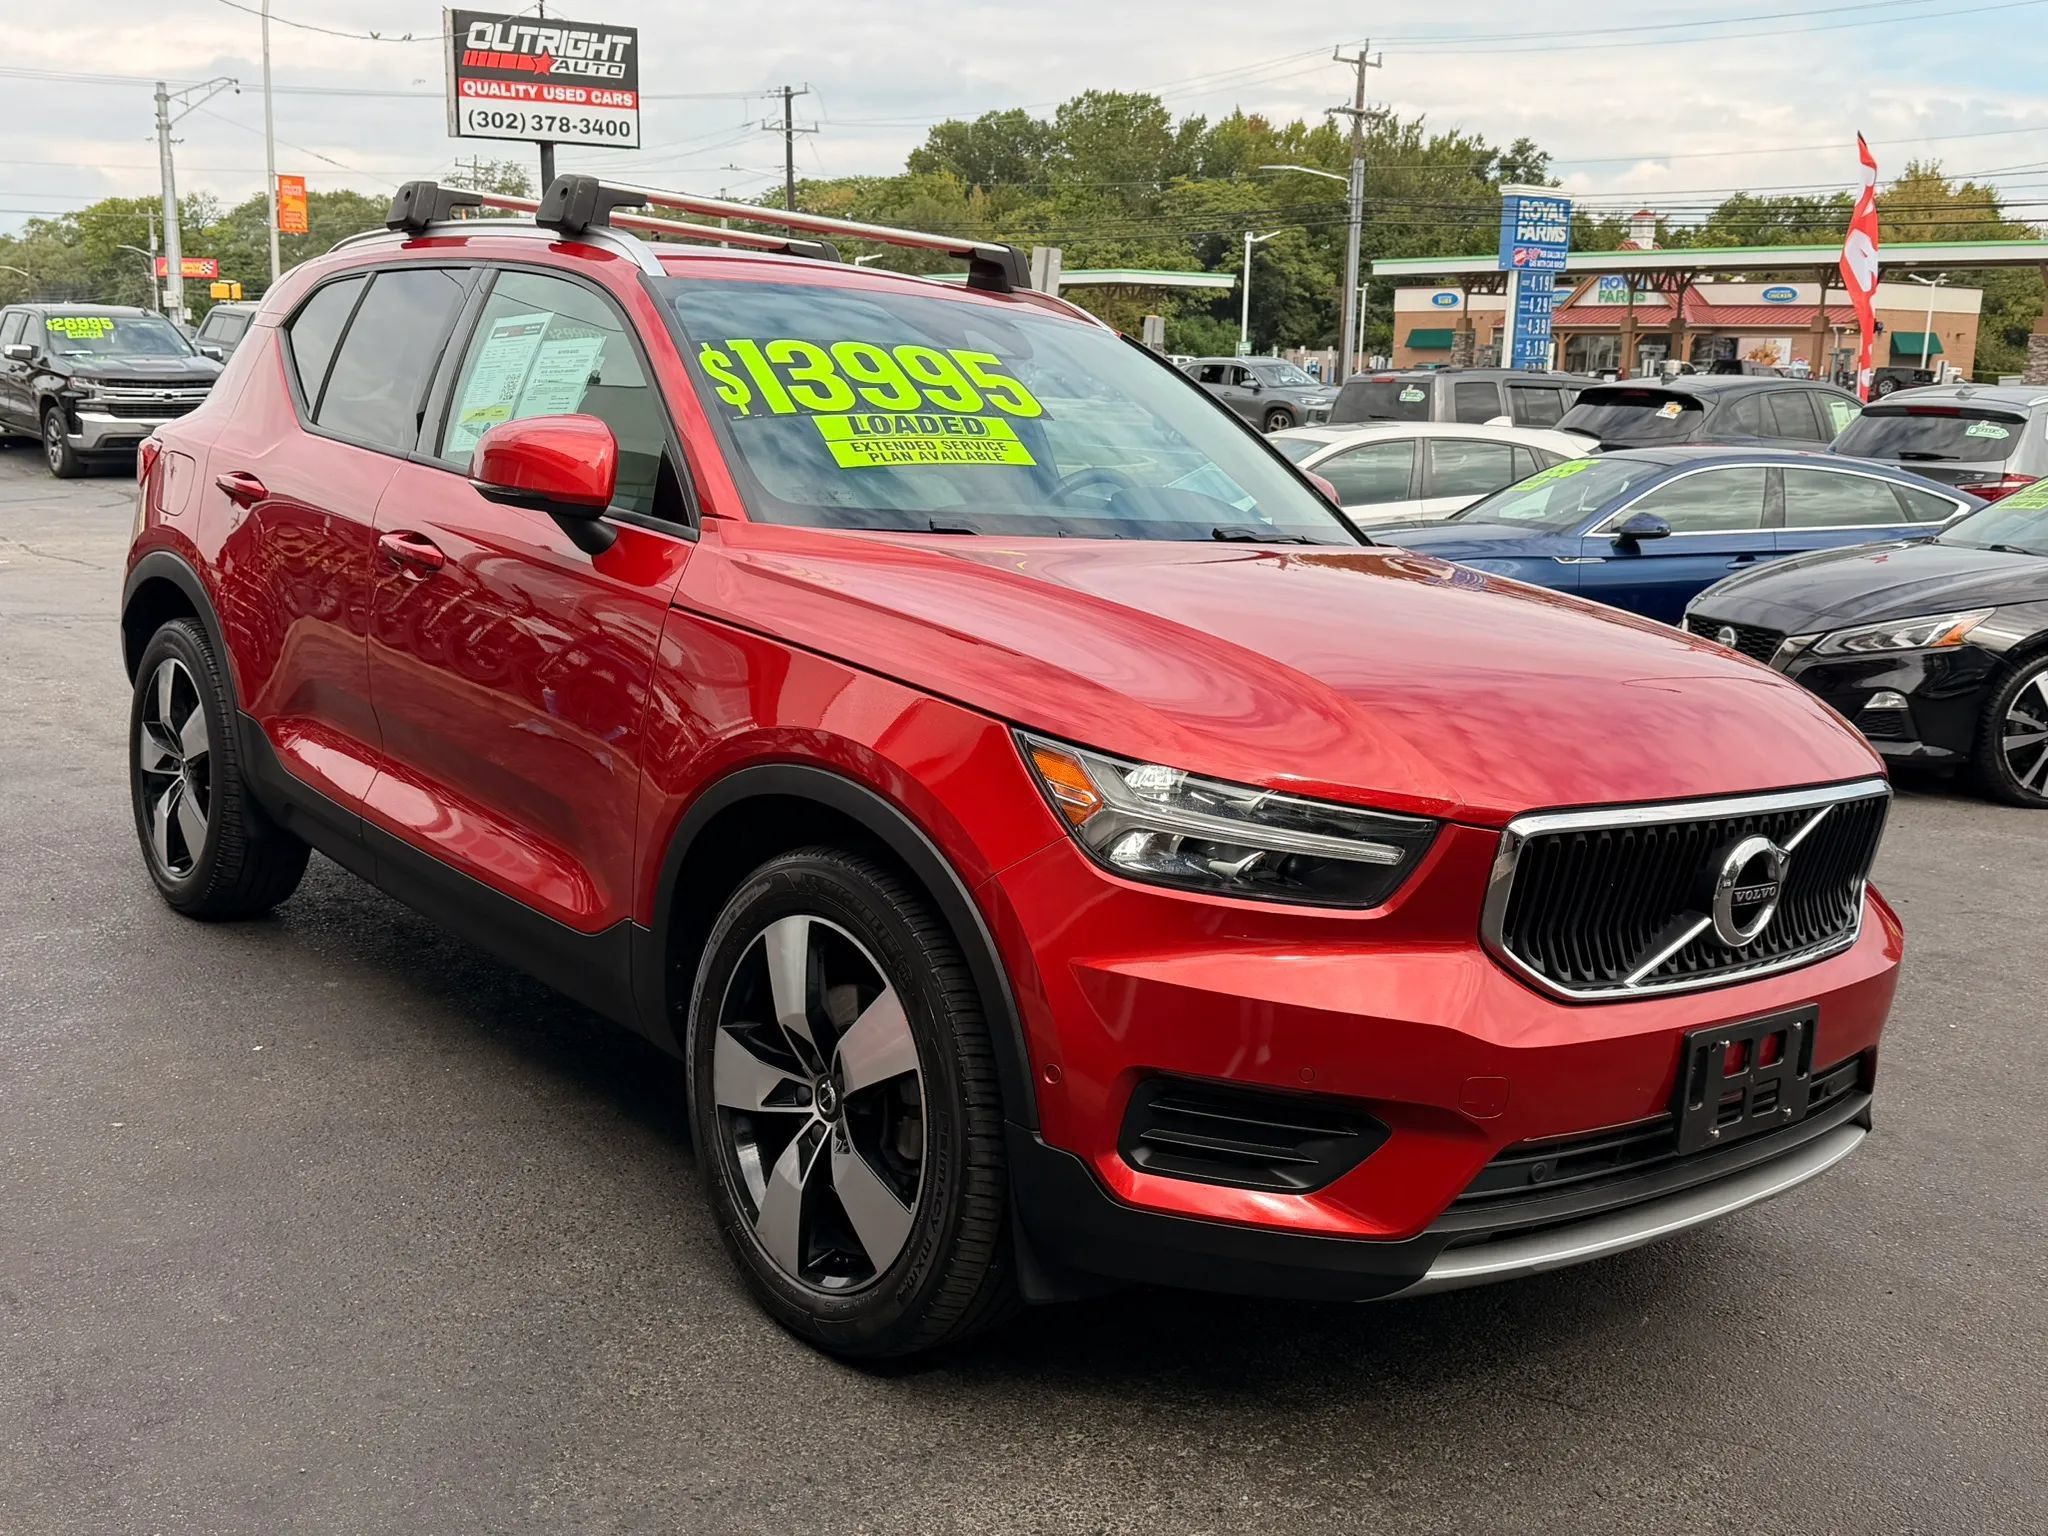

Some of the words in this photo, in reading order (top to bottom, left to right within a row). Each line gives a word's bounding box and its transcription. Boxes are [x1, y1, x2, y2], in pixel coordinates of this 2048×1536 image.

[466, 22, 632, 62] OUTRIGHT
[554, 60, 623, 76] AUTO
[463, 81, 539, 100] QUALITY
[543, 86, 587, 102] USED
[591, 90, 633, 107] CARS
[468, 110, 526, 134] (302)
[531, 115, 631, 138] 378-3400
[1518, 200, 1568, 223] ROYAL
[1516, 221, 1567, 243] FARMS
[1599, 276, 1647, 290] ROY
[699, 338, 1043, 419] $13995
[849, 415, 991, 439] LOADED
[850, 441, 937, 453] EXTENDED
[941, 440, 1009, 452] SERVICE
[868, 452, 915, 463] PLAN
[918, 450, 1006, 463] AVAILABLE
[1734, 886, 1776, 902] VOLVO
